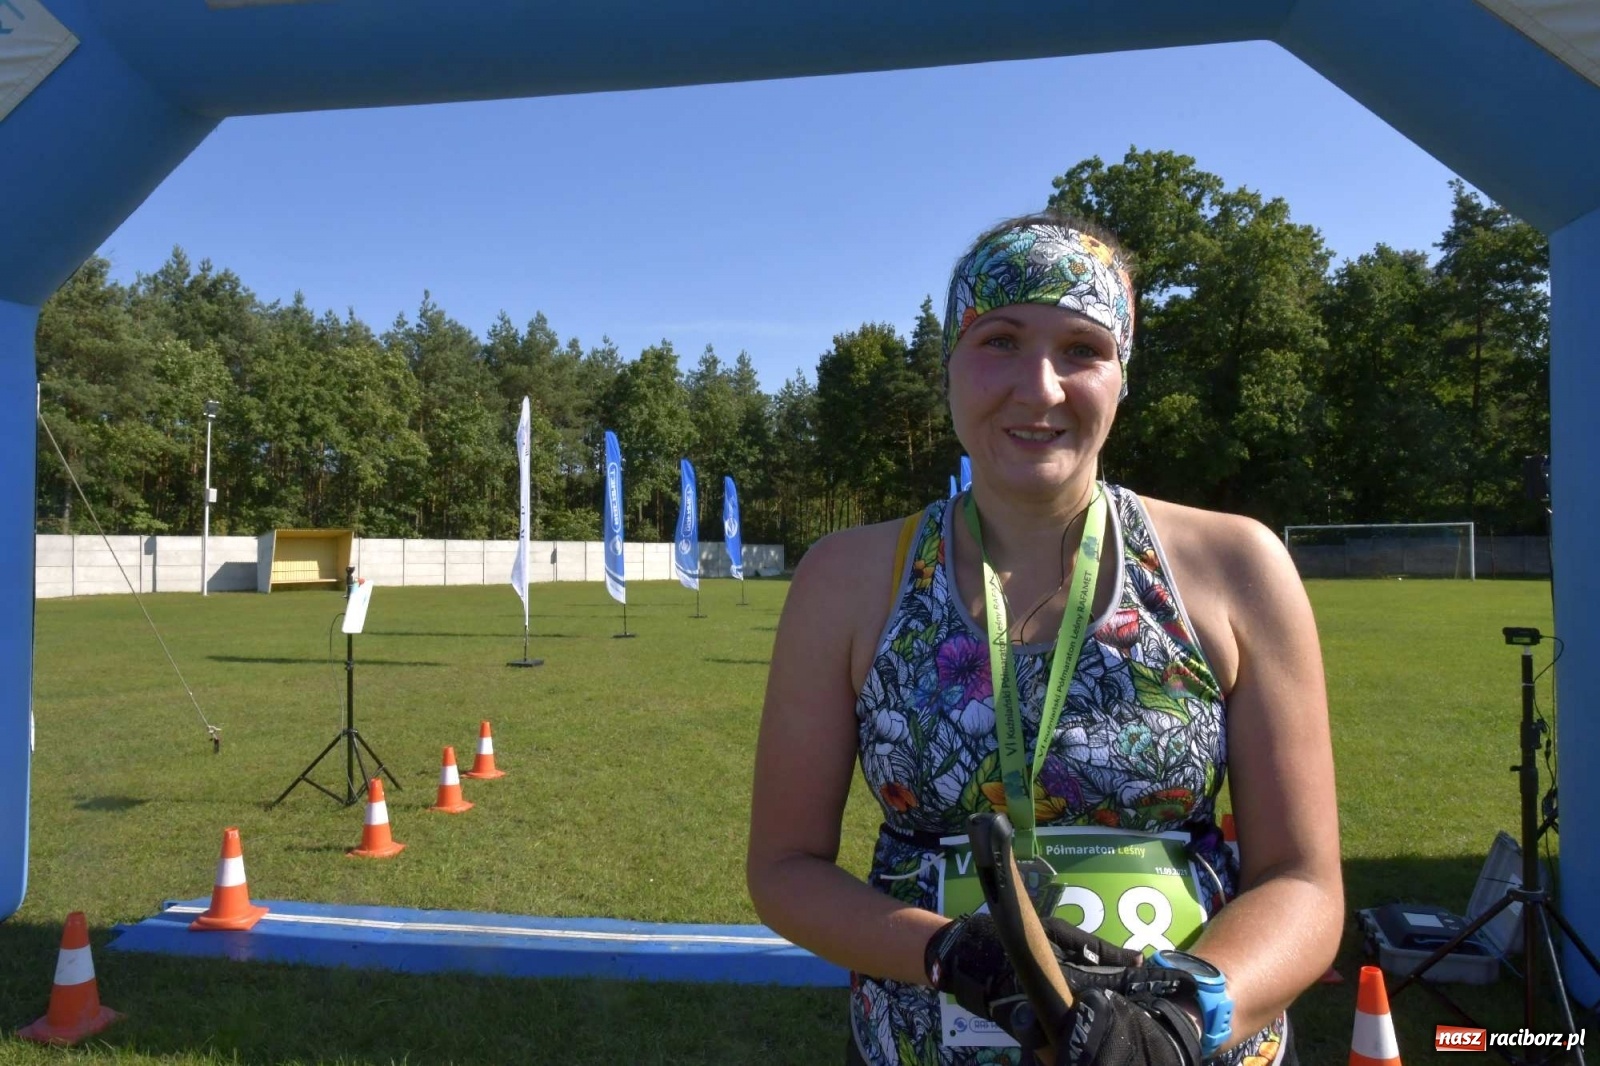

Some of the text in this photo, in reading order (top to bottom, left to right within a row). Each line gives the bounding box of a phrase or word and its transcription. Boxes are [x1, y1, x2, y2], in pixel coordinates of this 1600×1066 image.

[1077, 570, 1092, 612] RAFAMET
[1072, 614, 1083, 639] Leśny
[1002, 690, 1016, 739] Kuźniański
[1004, 742, 1017, 757] VI
[1046, 845, 1146, 858] Półmaraton Leśny
